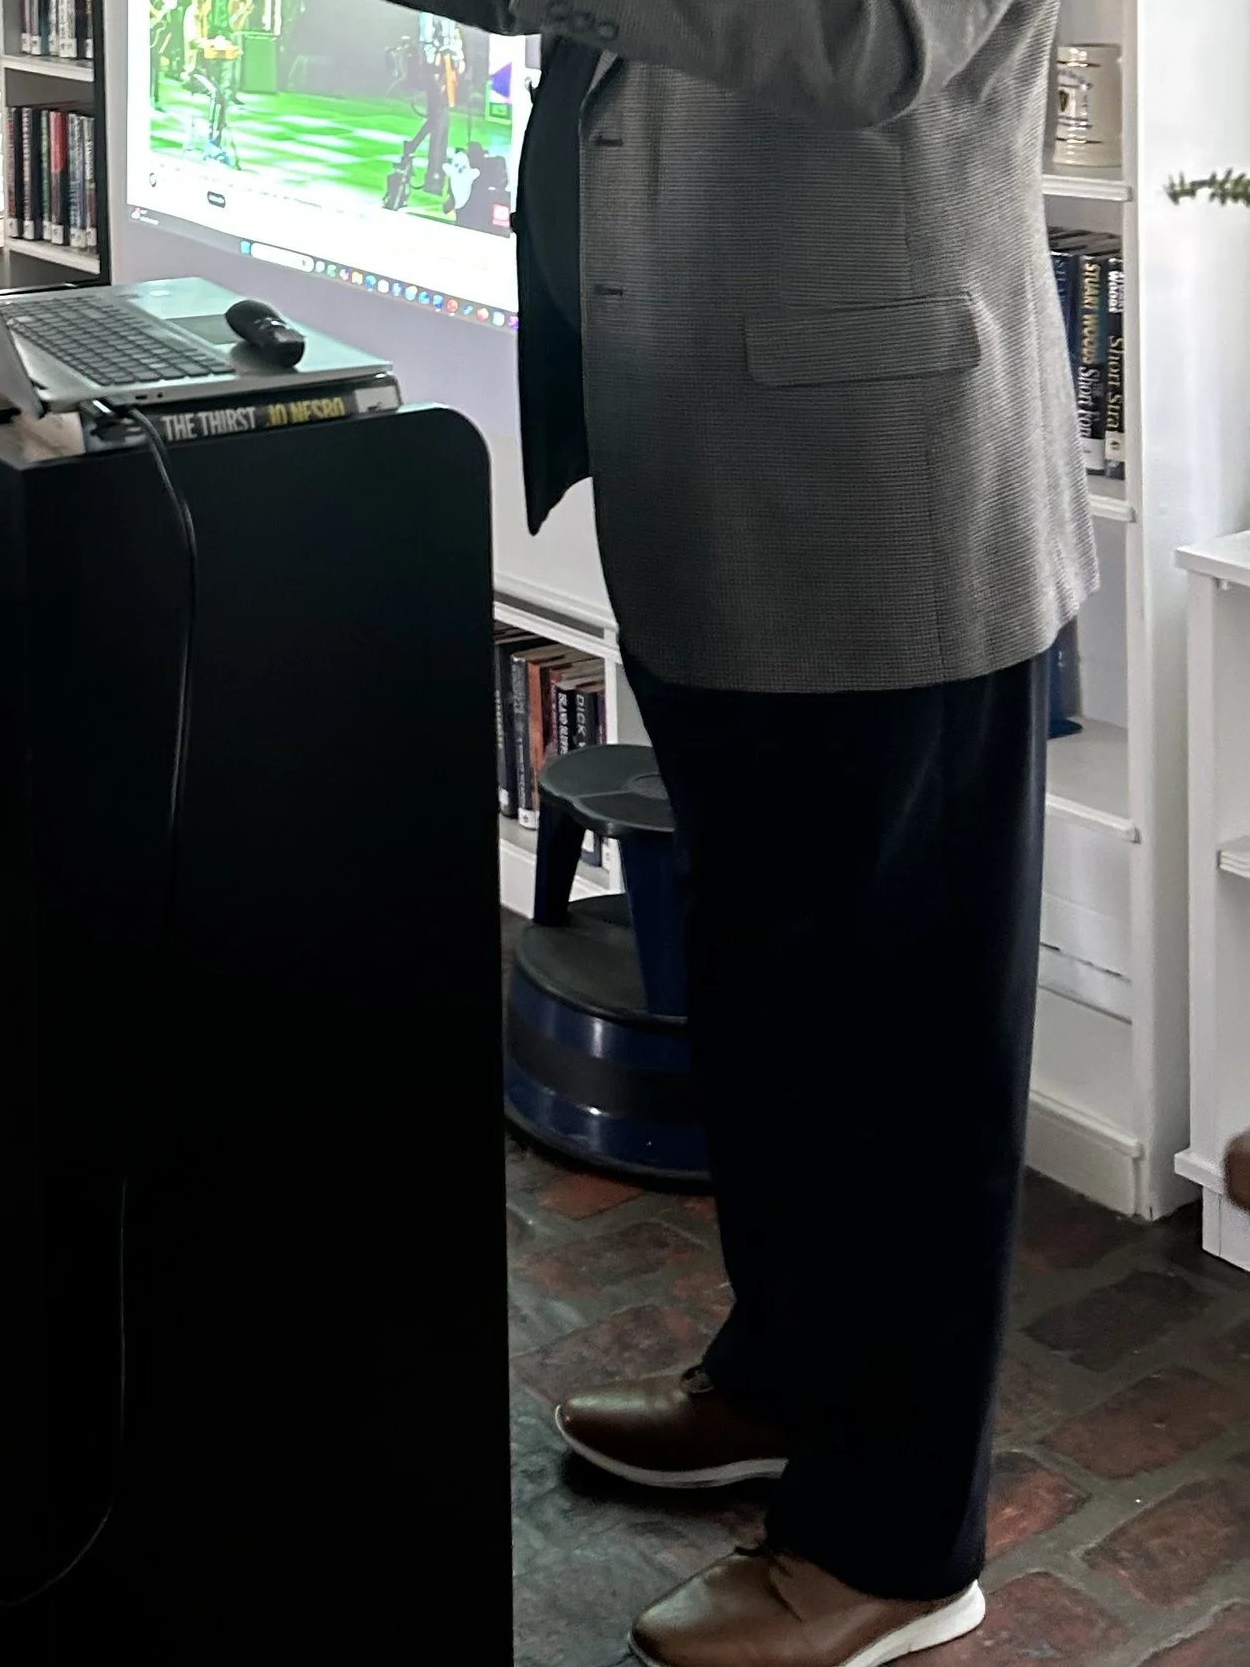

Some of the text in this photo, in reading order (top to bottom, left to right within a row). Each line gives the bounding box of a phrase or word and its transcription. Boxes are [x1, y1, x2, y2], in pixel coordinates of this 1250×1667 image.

[1082, 263, 1101, 365] STUART WOODS
[1106, 336, 1124, 432] Short Stra
[162, 414, 198, 442] THE
[200, 406, 257, 436] THIRST
[576, 694, 586, 735] DICK
